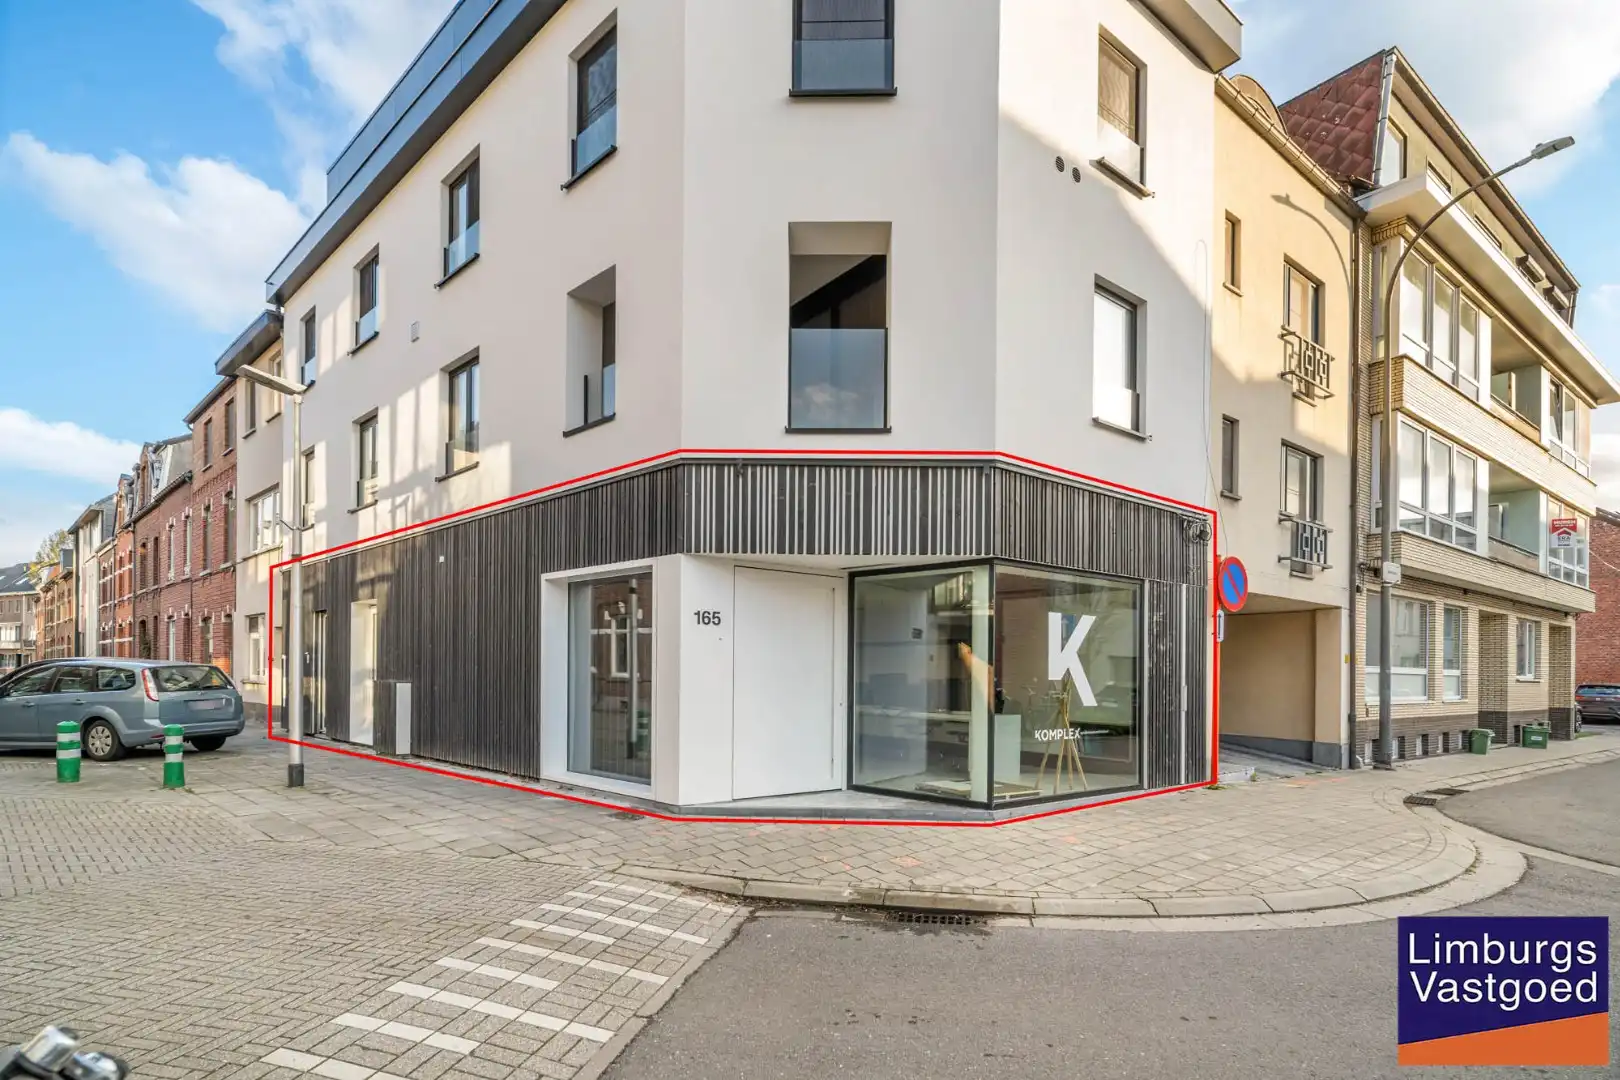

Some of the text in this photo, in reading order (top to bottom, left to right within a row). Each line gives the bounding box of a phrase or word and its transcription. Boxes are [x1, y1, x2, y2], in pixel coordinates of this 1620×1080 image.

[693, 610, 722, 626] 165
[1048, 611, 1098, 707] K
[1034, 727, 1081, 742] KOMPLEX
